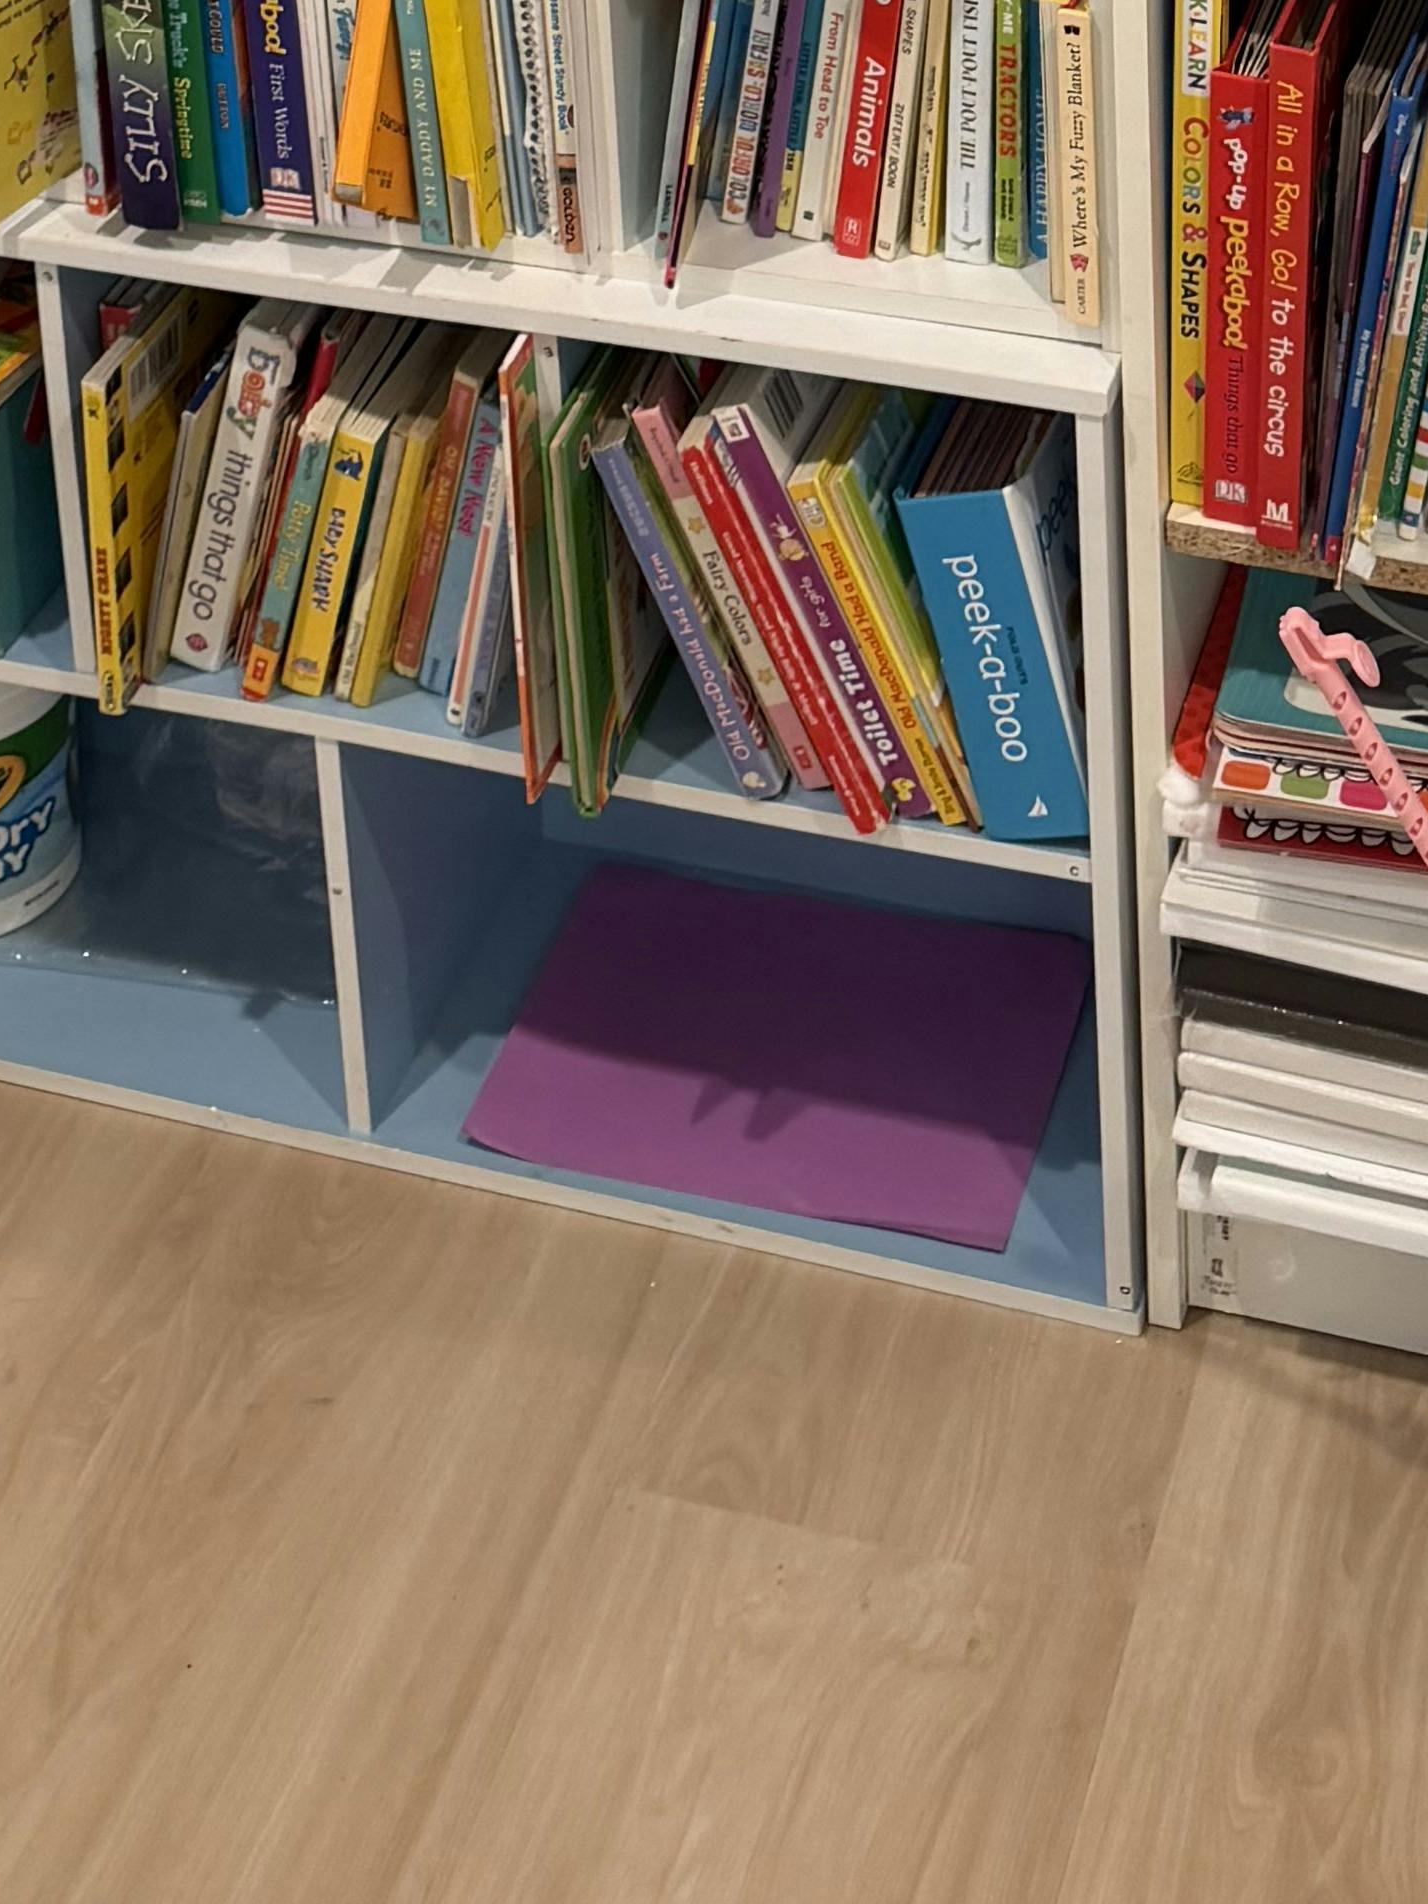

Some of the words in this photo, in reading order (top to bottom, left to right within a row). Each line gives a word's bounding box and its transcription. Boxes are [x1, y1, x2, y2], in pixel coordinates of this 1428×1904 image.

[825, 12, 844, 52] From
[269, 63, 289, 101] First
[820, 55, 840, 97] Head
[999, 44, 1018, 157] TRACTORS
[1276, 81, 1304, 115] All
[119, 75, 168, 183] SILLY
[272, 105, 293, 159] Words
[813, 118, 832, 140] Toe
[818, 101, 835, 116] to
[851, 57, 887, 168] Animals
[1276, 124, 1298, 148] in
[1224, 137, 1249, 210] pop-up
[1276, 156, 1294, 171] a
[1269, 180, 1300, 238] Row,
[1219, 216, 1252, 348] peekaboo!
[1271, 248, 1299, 291] Go!
[1270, 299, 1296, 326] to
[1267, 335, 1294, 376] the
[224, 345, 281, 441] baby
[1224, 356, 1245, 412] Things
[1224, 416, 1244, 448] that
[1264, 384, 1290, 457] circus
[206, 450, 254, 527] things
[1220, 452, 1240, 474] go
[323, 507, 347, 548] BABY
[202, 529, 236, 581] that
[310, 547, 340, 613] SHARK
[188, 581, 219, 620] go
[702, 551, 729, 593] Fairy
[719, 594, 754, 646] Colors
[827, 639, 867, 695] Time
[943, 554, 1030, 763] peek-a-boo
[860, 707, 899, 767] Toilet
